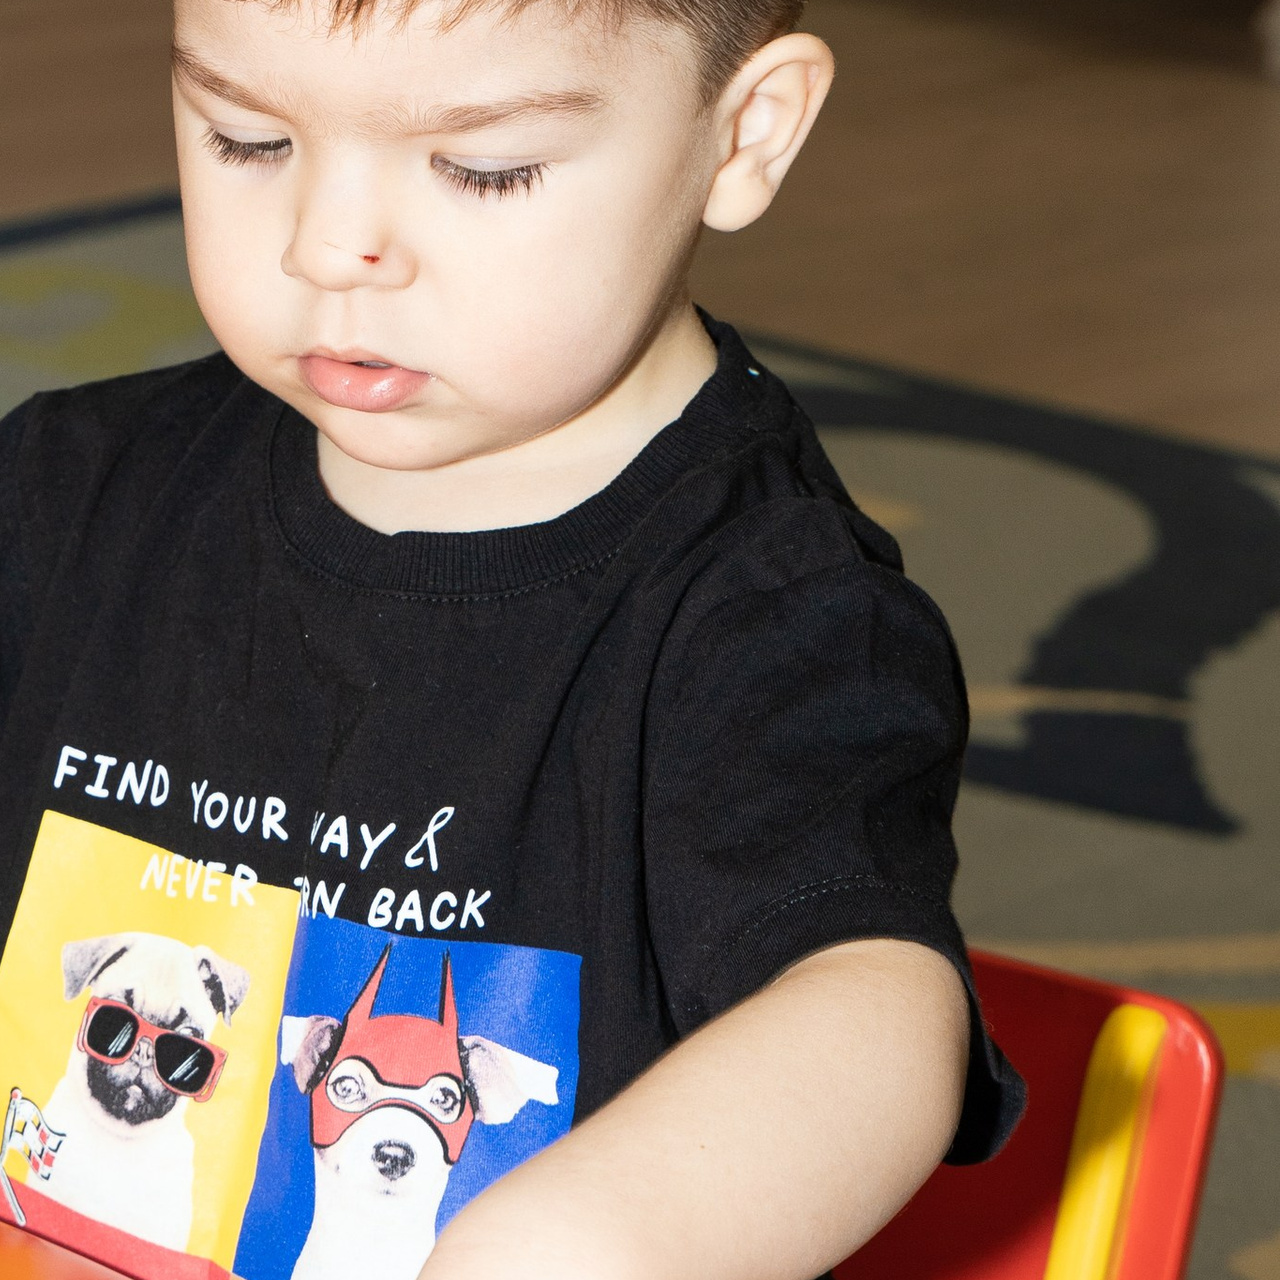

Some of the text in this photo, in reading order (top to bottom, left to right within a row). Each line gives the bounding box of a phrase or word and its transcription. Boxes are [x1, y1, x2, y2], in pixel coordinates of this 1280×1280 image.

[53, 745, 170, 807] FIND
[191, 779, 289, 840] YOUR
[404, 806, 455, 871] &
[140, 853, 258, 907] NEVER
[367, 887, 491, 931] BACK
